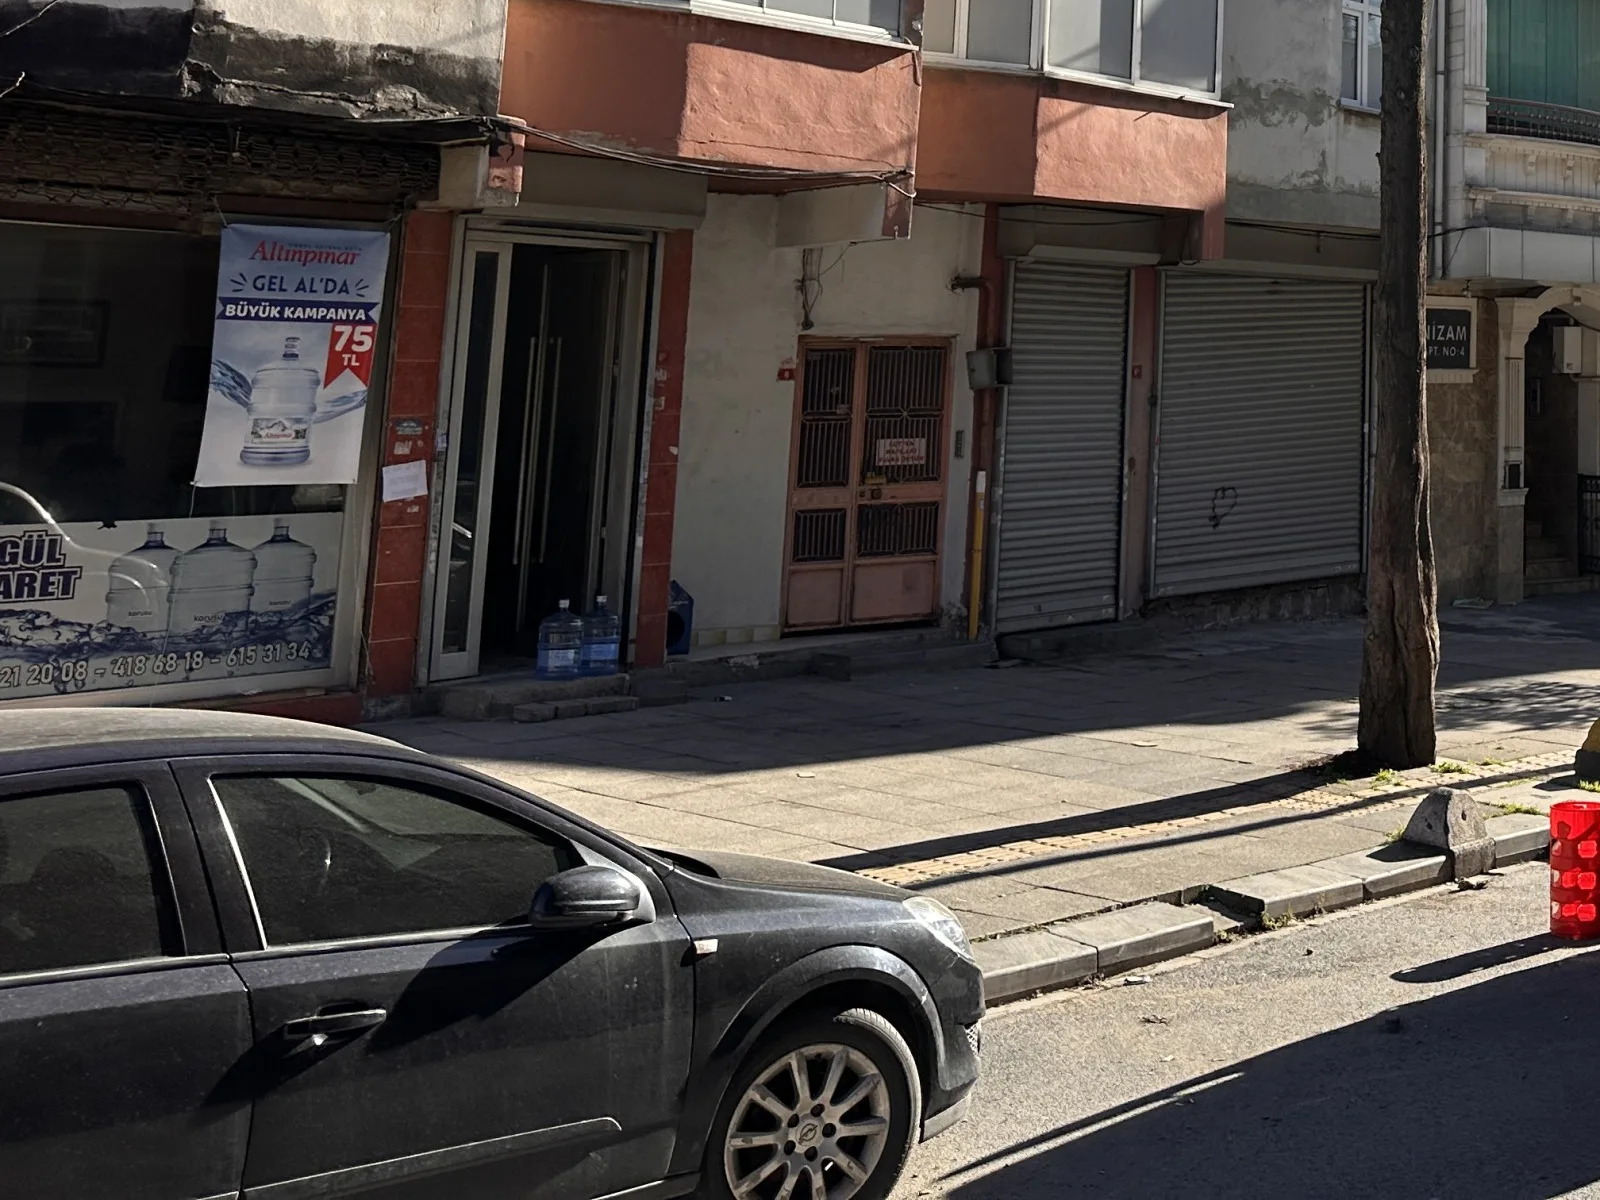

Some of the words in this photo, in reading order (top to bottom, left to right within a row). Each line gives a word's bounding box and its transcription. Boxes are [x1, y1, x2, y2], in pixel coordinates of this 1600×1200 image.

[253, 275, 287, 292] GEL
[294, 277, 350, 295] AL'DA
[225, 302, 280, 318] BÜYÜK
[284, 306, 366, 320] KAMPANYA
[334, 325, 373, 352] 75
[342, 354, 360, 366] TL
[0, 532, 63, 568] GÜL
[0, 569, 80, 601] ARET
[0, 666, 21, 687] 21
[26, 663, 54, 686] 20
[61, 660, 88, 682] 08
[112, 655, 146, 677] 418
[153, 653, 178, 674] 68
[184, 650, 204, 670] 18
[226, 646, 256, 667] 615
[262, 644, 281, 663] 31
[287, 641, 310, 660] 34
